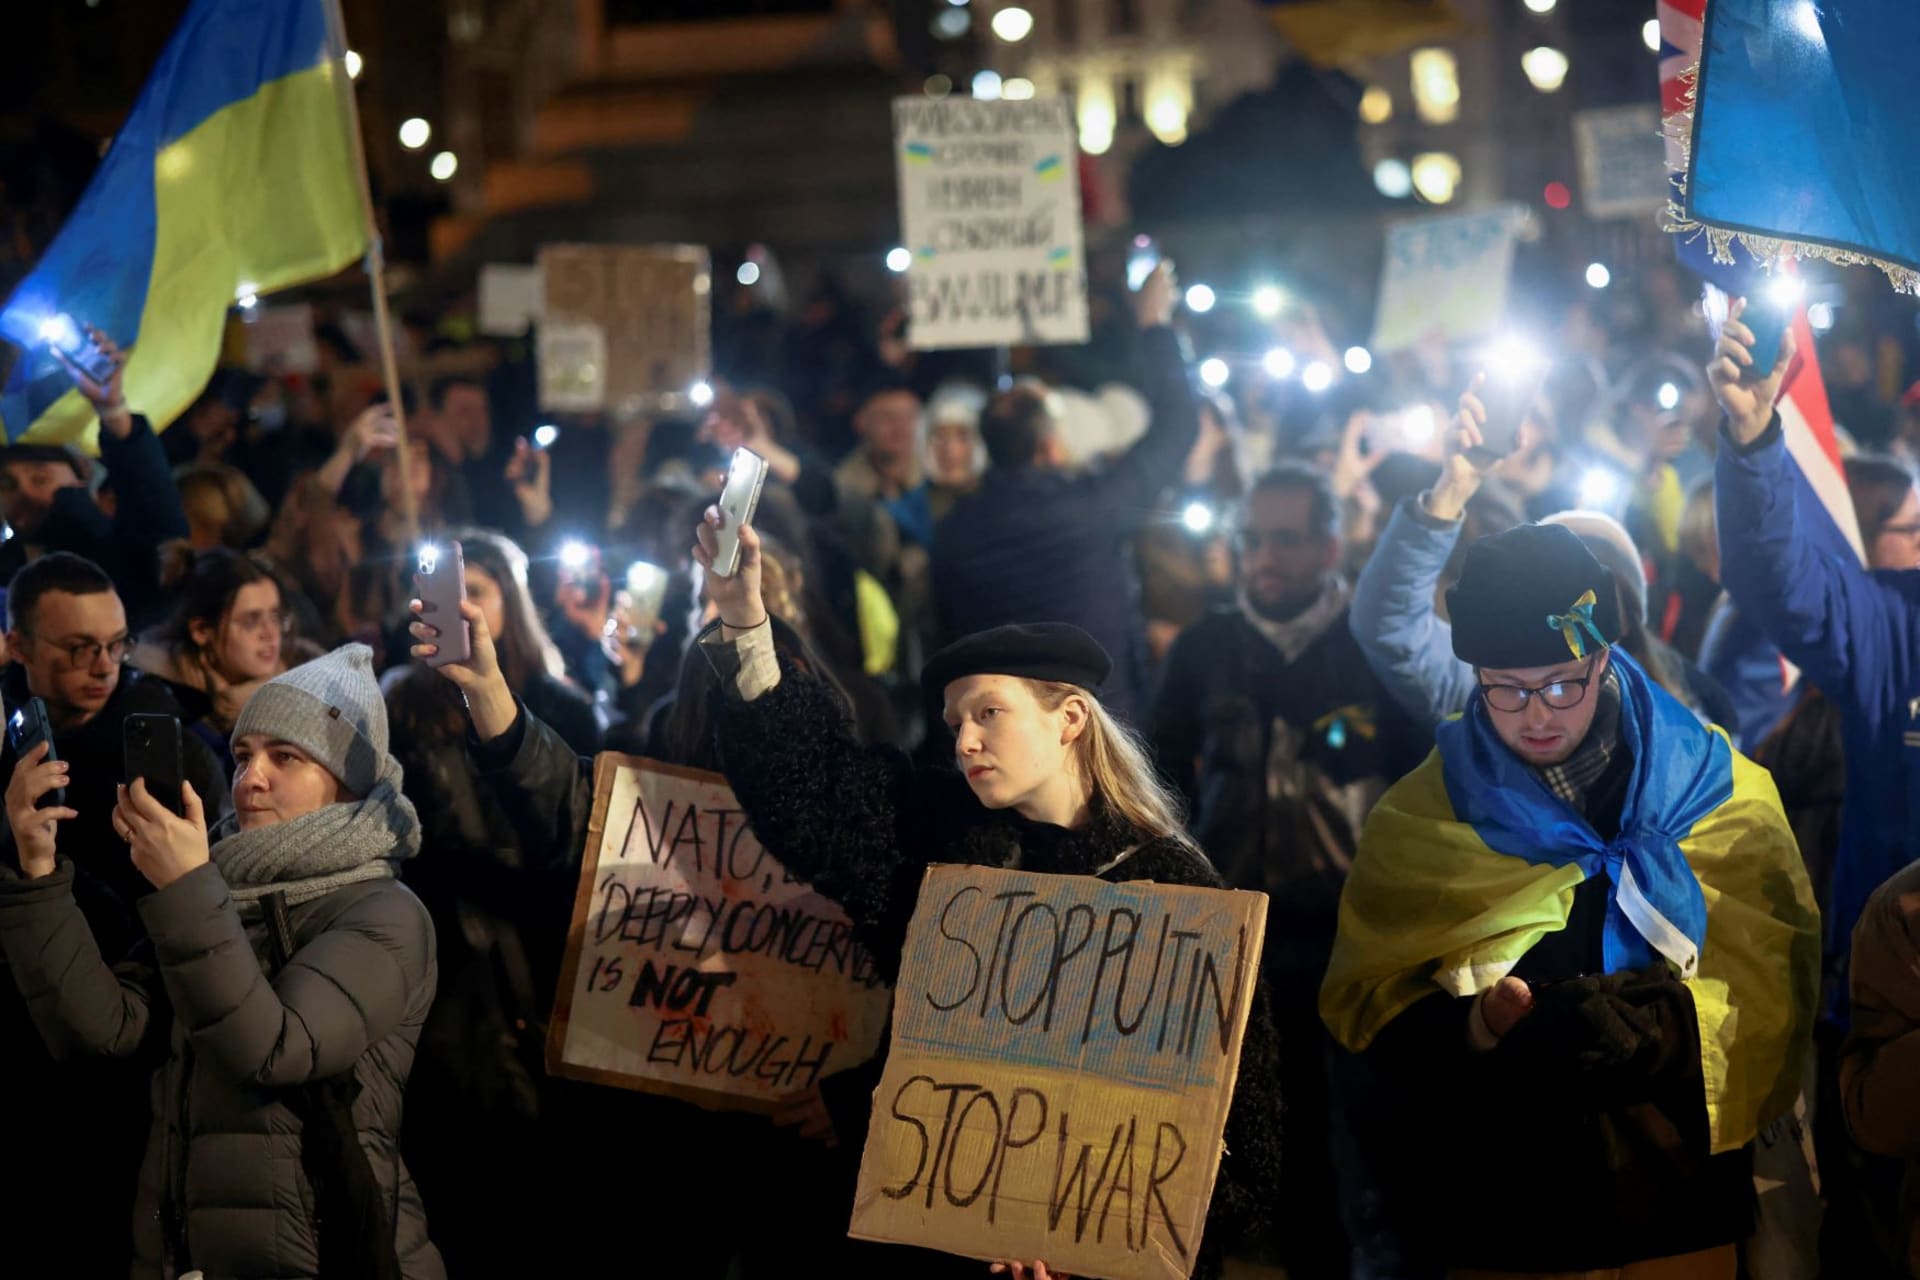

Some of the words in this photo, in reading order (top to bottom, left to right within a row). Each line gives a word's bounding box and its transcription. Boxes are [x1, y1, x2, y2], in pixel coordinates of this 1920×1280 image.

[587, 957, 623, 993] IS
[629, 961, 738, 1017] NOT
[926, 886, 1097, 1033] STOP
[1081, 905, 1246, 1056] PUTIN
[647, 1018, 834, 1089] ENOUGH
[881, 1075, 1048, 1225] STOP
[1048, 1112, 1189, 1260] WAR
